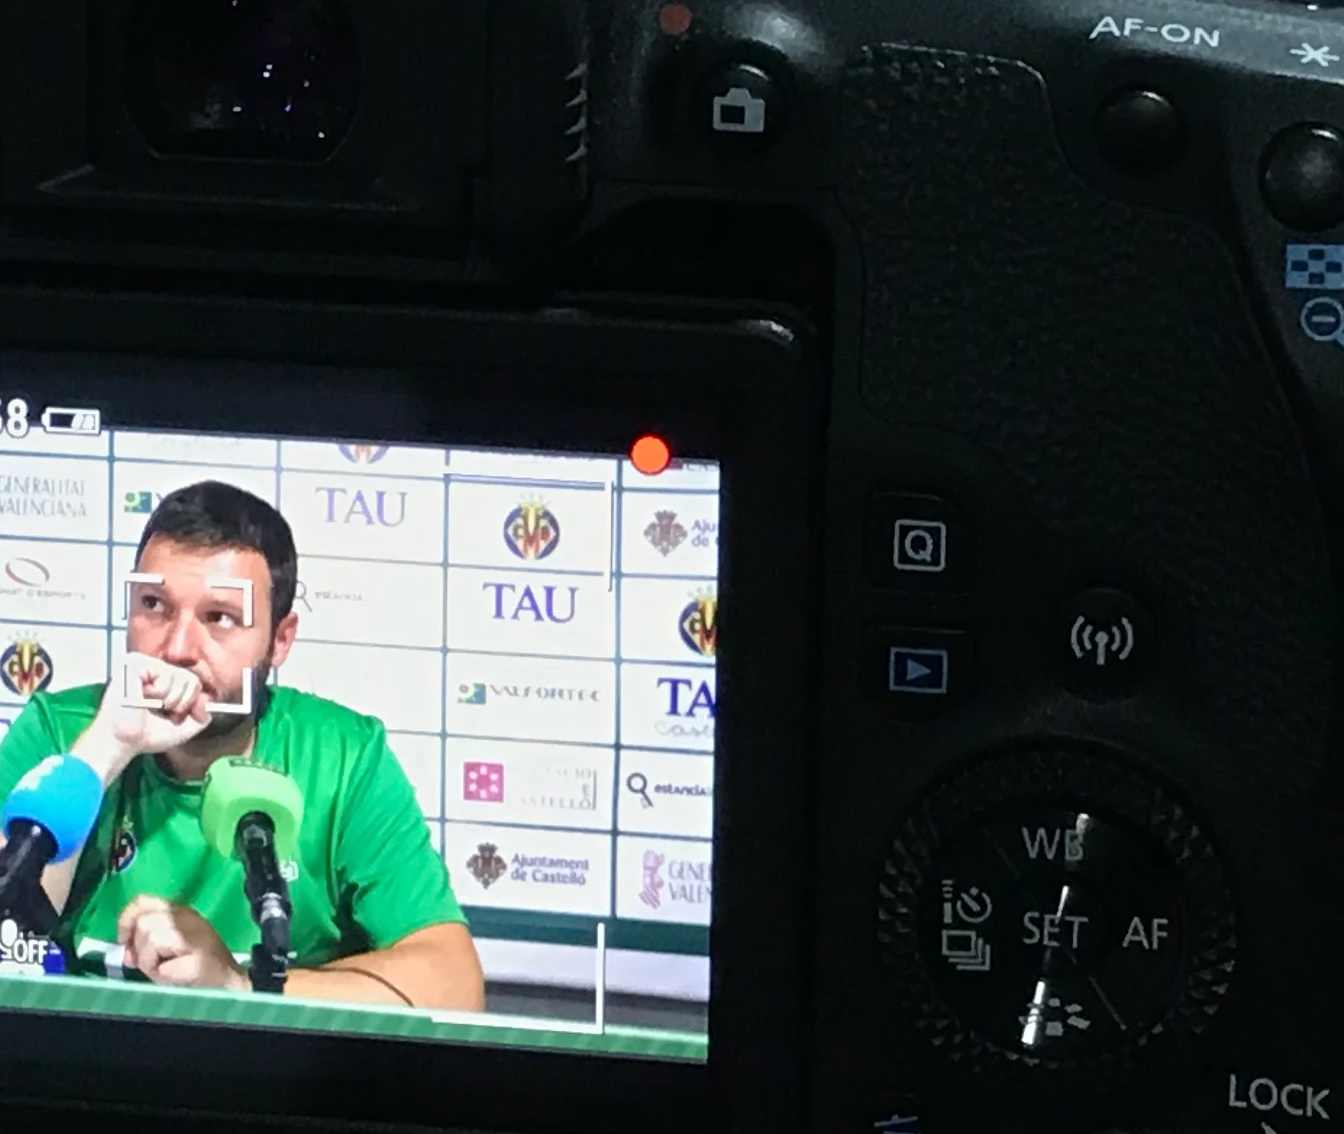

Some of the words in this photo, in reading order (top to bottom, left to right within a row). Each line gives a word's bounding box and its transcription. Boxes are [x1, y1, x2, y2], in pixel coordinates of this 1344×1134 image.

[1088, 15, 1221, 48] AF-ON
[314, 486, 408, 528] TAU
[482, 581, 579, 624] TAU
[656, 676, 717, 719] TA
[510, 852, 590, 871] Ajuntament
[1021, 828, 1086, 863] WB
[1022, 912, 1089, 949] SET
[1122, 918, 1169, 951] AF
[13, 938, 49, 965] OFF
[1228, 1073, 1331, 1121] LOCK
